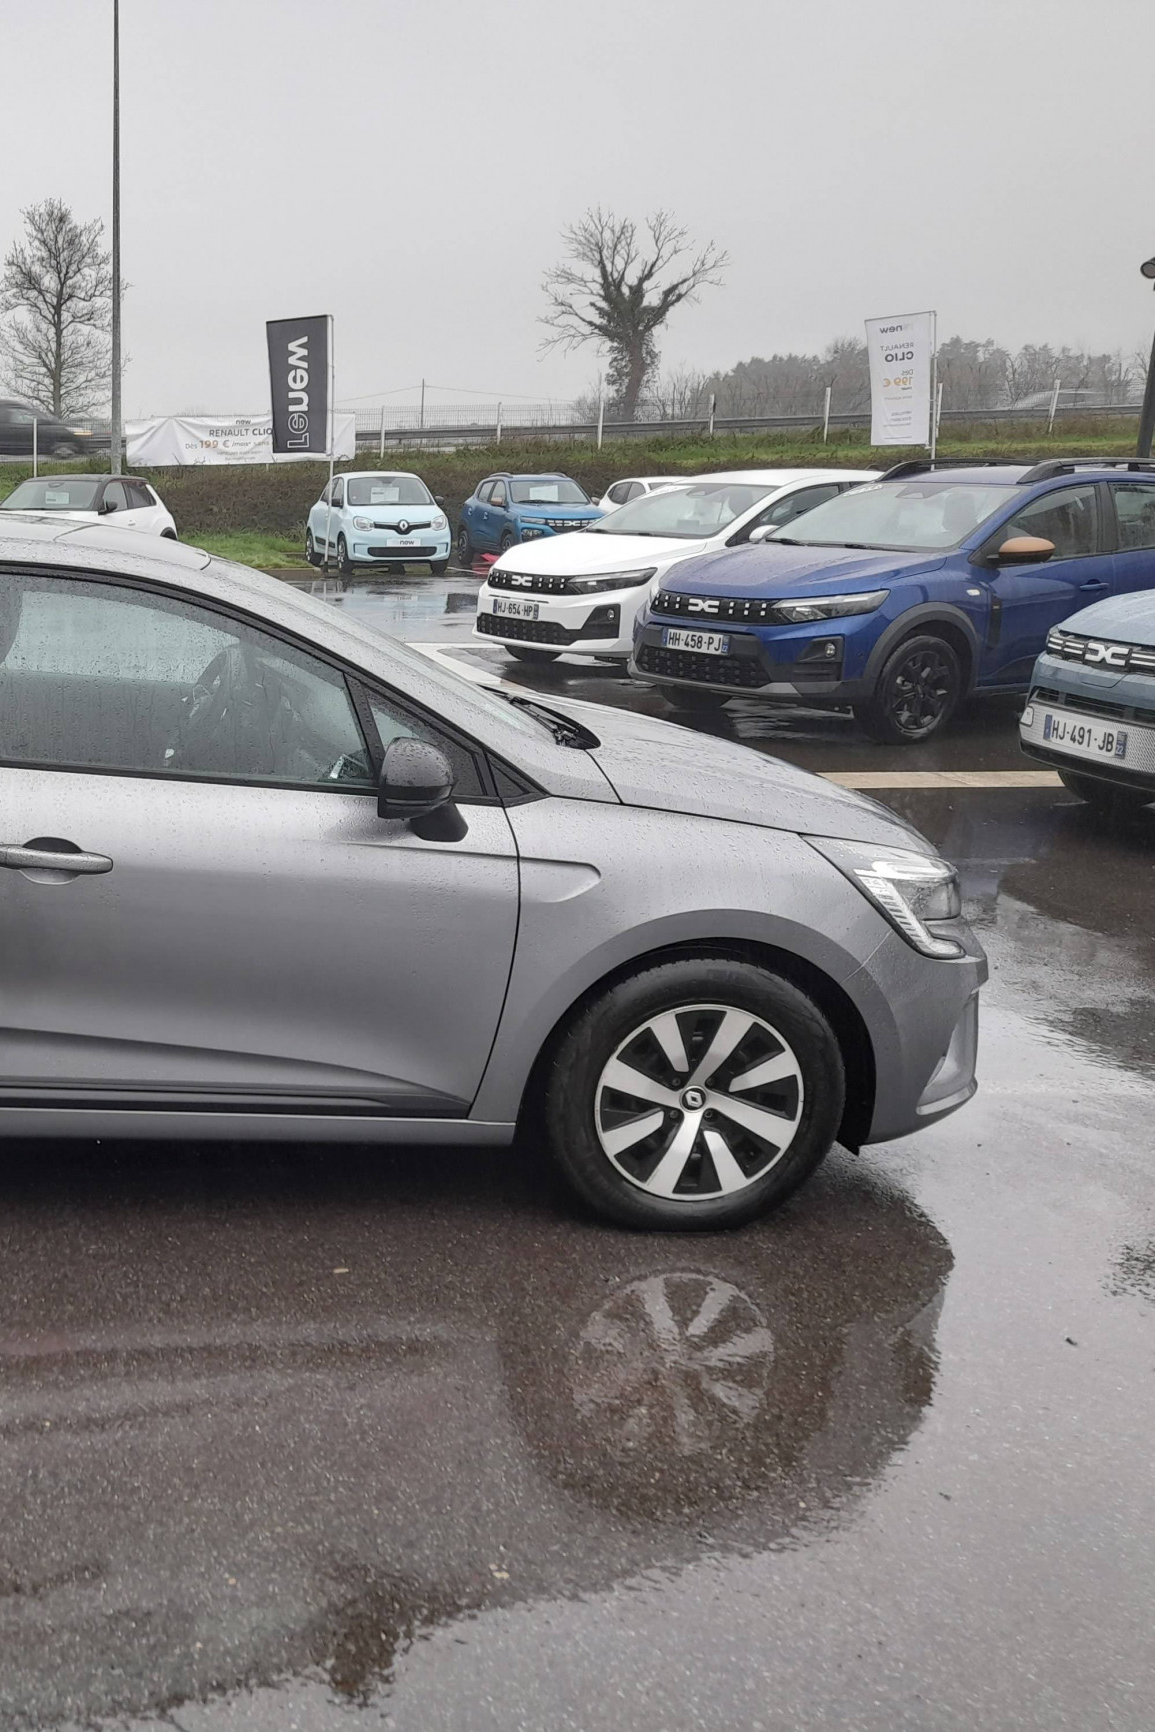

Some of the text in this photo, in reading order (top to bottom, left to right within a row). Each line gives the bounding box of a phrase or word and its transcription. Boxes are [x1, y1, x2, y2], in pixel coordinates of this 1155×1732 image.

[209, 428, 250, 438] RENAULT
[199, 440, 219, 449] 199
[497, 601, 533, 617] HJ-654-HP
[667, 631, 722, 652] HH-458-PJ
[1051, 719, 1115, 752] HJ-491-JB
